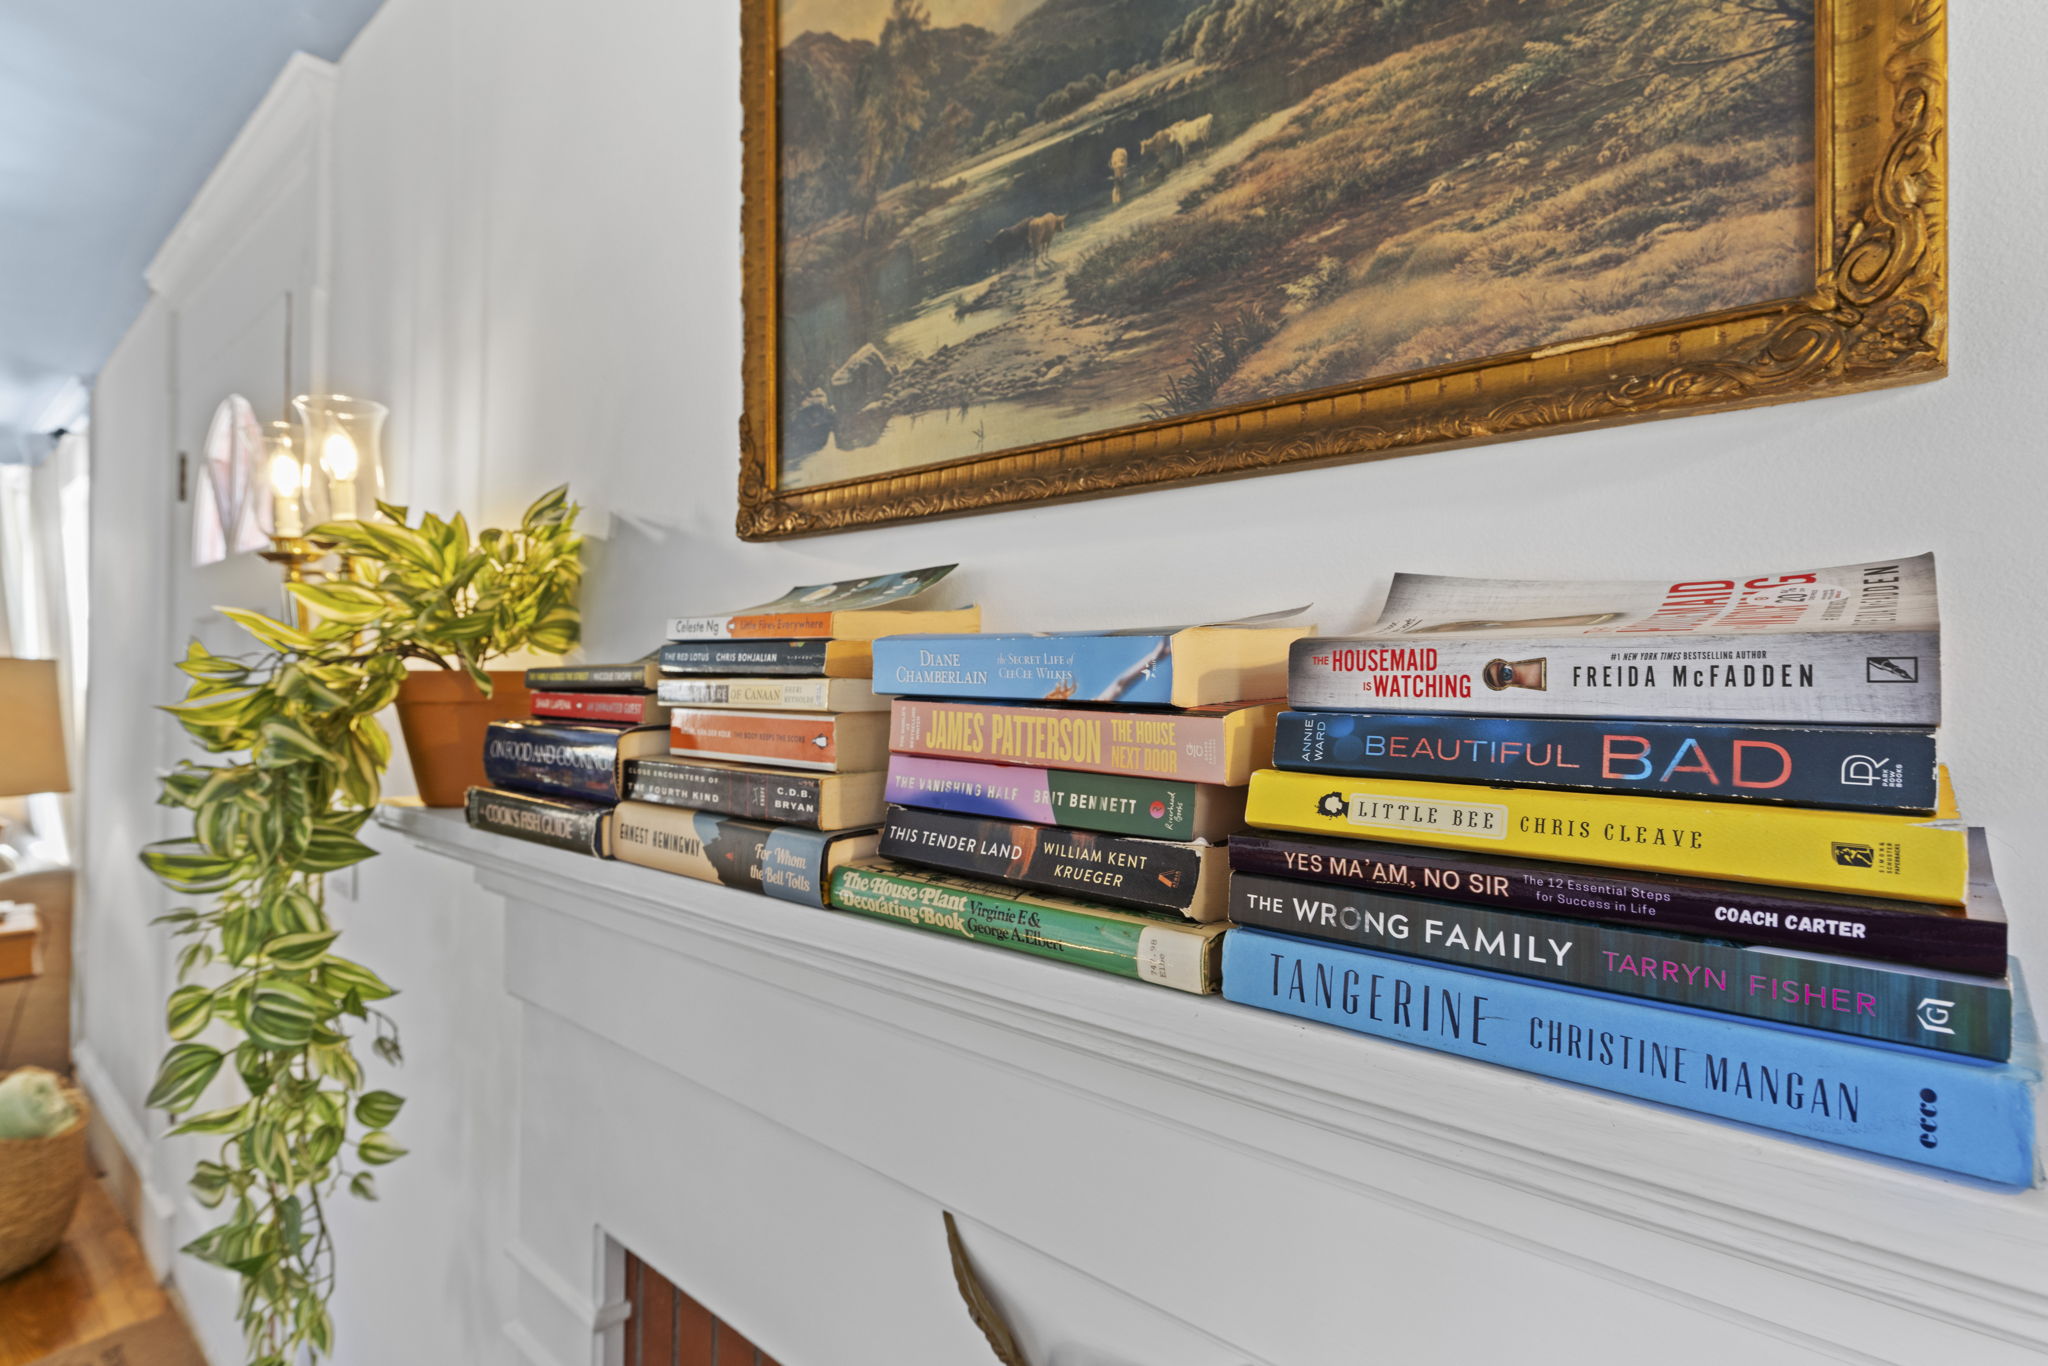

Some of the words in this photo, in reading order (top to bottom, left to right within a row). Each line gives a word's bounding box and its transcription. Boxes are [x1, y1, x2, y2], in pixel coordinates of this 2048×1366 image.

[675, 620, 704, 633] Celeste
[706, 620, 719, 635] Ng
[777, 618, 823, 632] Everywhere
[665, 652, 675, 661] THE
[676, 652, 689, 661] RED
[690, 652, 709, 661] LOTUS
[716, 652, 736, 662] CHRIS
[737, 652, 777, 663] BOHJALIAN
[920, 649, 960, 667] DIANE
[1007, 653, 1041, 665] SECRET
[1044, 653, 1064, 666] LIFE
[1065, 653, 1074, 667] of
[1312, 656, 1329, 666] THE
[1332, 648, 1438, 672] HOUSEMAID
[1611, 652, 1621, 661] #1
[1622, 652, 1638, 661] NEW
[1639, 652, 1658, 661] YORK
[1659, 652, 1682, 661] TIMES
[1683, 651, 1733, 661] BESTSELLING
[1736, 650, 1767, 660] AUTHOR
[896, 667, 988, 685] CHAMBERLAIN
[1036, 667, 1073, 681] WILKES
[1363, 680, 1372, 692] IS
[1373, 674, 1472, 698] WATCHING
[1572, 664, 1656, 688] FREIDA
[1673, 663, 1814, 688] McFADDEN
[744, 688, 781, 701] CANAAN
[926, 709, 984, 751] JAMES
[992, 713, 1101, 764] PATTERSON
[1111, 719, 1133, 742] THE
[1136, 720, 1176, 746] HOUSE
[1302, 719, 1314, 762] ANNIE
[1314, 721, 1326, 761] WARD
[1111, 748, 1141, 772] NEXT
[1144, 750, 1178, 774] DOOR
[1365, 735, 1580, 768] BEAUTIFUL
[1602, 734, 1793, 789] BAD
[628, 766, 651, 777] CLOSE
[653, 769, 706, 783] ENCOUNTERS
[708, 776, 719, 785] OF
[895, 775, 916, 791] THE
[919, 777, 982, 798] VANISHING
[987, 785, 1020, 801] HALF
[627, 781, 645, 793] THE
[649, 784, 688, 799] FOURTH
[692, 791, 720, 803] KIND
[777, 787, 812, 799] C.D.B.
[1033, 790, 1064, 806] BRIT
[1069, 794, 1137, 814] BENNETT
[774, 799, 814, 813] BRYAN
[1357, 800, 1438, 824] LITTLE
[1452, 809, 1494, 830] BEE
[541, 815, 573, 839] GUIDE
[1519, 815, 1590, 838] CHRIS
[1604, 822, 1702, 850] CLEAVE
[620, 823, 649, 846] ERNEST
[652, 830, 701, 858] HEMINGWAY
[889, 826, 918, 844] THIS
[921, 832, 976, 854] TENDER
[980, 840, 1023, 860] LAND
[754, 843, 771, 861] For
[772, 847, 807, 870] Whom
[1043, 842, 1103, 863] WILLIAM
[1107, 852, 1148, 870] KENT
[750, 863, 764, 881] the
[764, 867, 785, 887] Bell
[785, 871, 811, 893] Tolls
[1053, 864, 1124, 887] KRUEGER
[1284, 850, 1323, 873] YES
[1424, 868, 1460, 890] NO
[1469, 874, 1509, 897] SIR
[843, 871, 869, 892] The
[871, 876, 918, 902] House
[918, 887, 966, 912] Plant
[1523, 874, 1544, 887] The
[1547, 876, 1563, 890] 12
[1567, 879, 1628, 897] Essential
[1631, 886, 1671, 903] Steps
[839, 890, 918, 924] Decorating
[918, 902, 975, 938] Book
[969, 900, 1016, 924] Virginie
[1536, 889, 1555, 904] for
[1557, 891, 1611, 911] Success
[1614, 899, 1627, 912] in
[1631, 900, 1656, 916] Life
[967, 918, 1008, 940] George
[1247, 894, 1283, 914] THE
[1293, 898, 1409, 939] WRONG
[1425, 919, 1573, 966] FAMILY
[1715, 906, 1778, 928] COACH
[1784, 914, 1866, 939] CARTER
[1602, 950, 1727, 991] TARRYN
[1750, 975, 1877, 1017] FISHER
[1270, 953, 1489, 1046] TANGERINE
[1530, 1016, 1688, 1085] CHRISTINE
[1705, 1053, 1859, 1123] MANGAN
[1919, 1087, 1939, 1149] ecco
